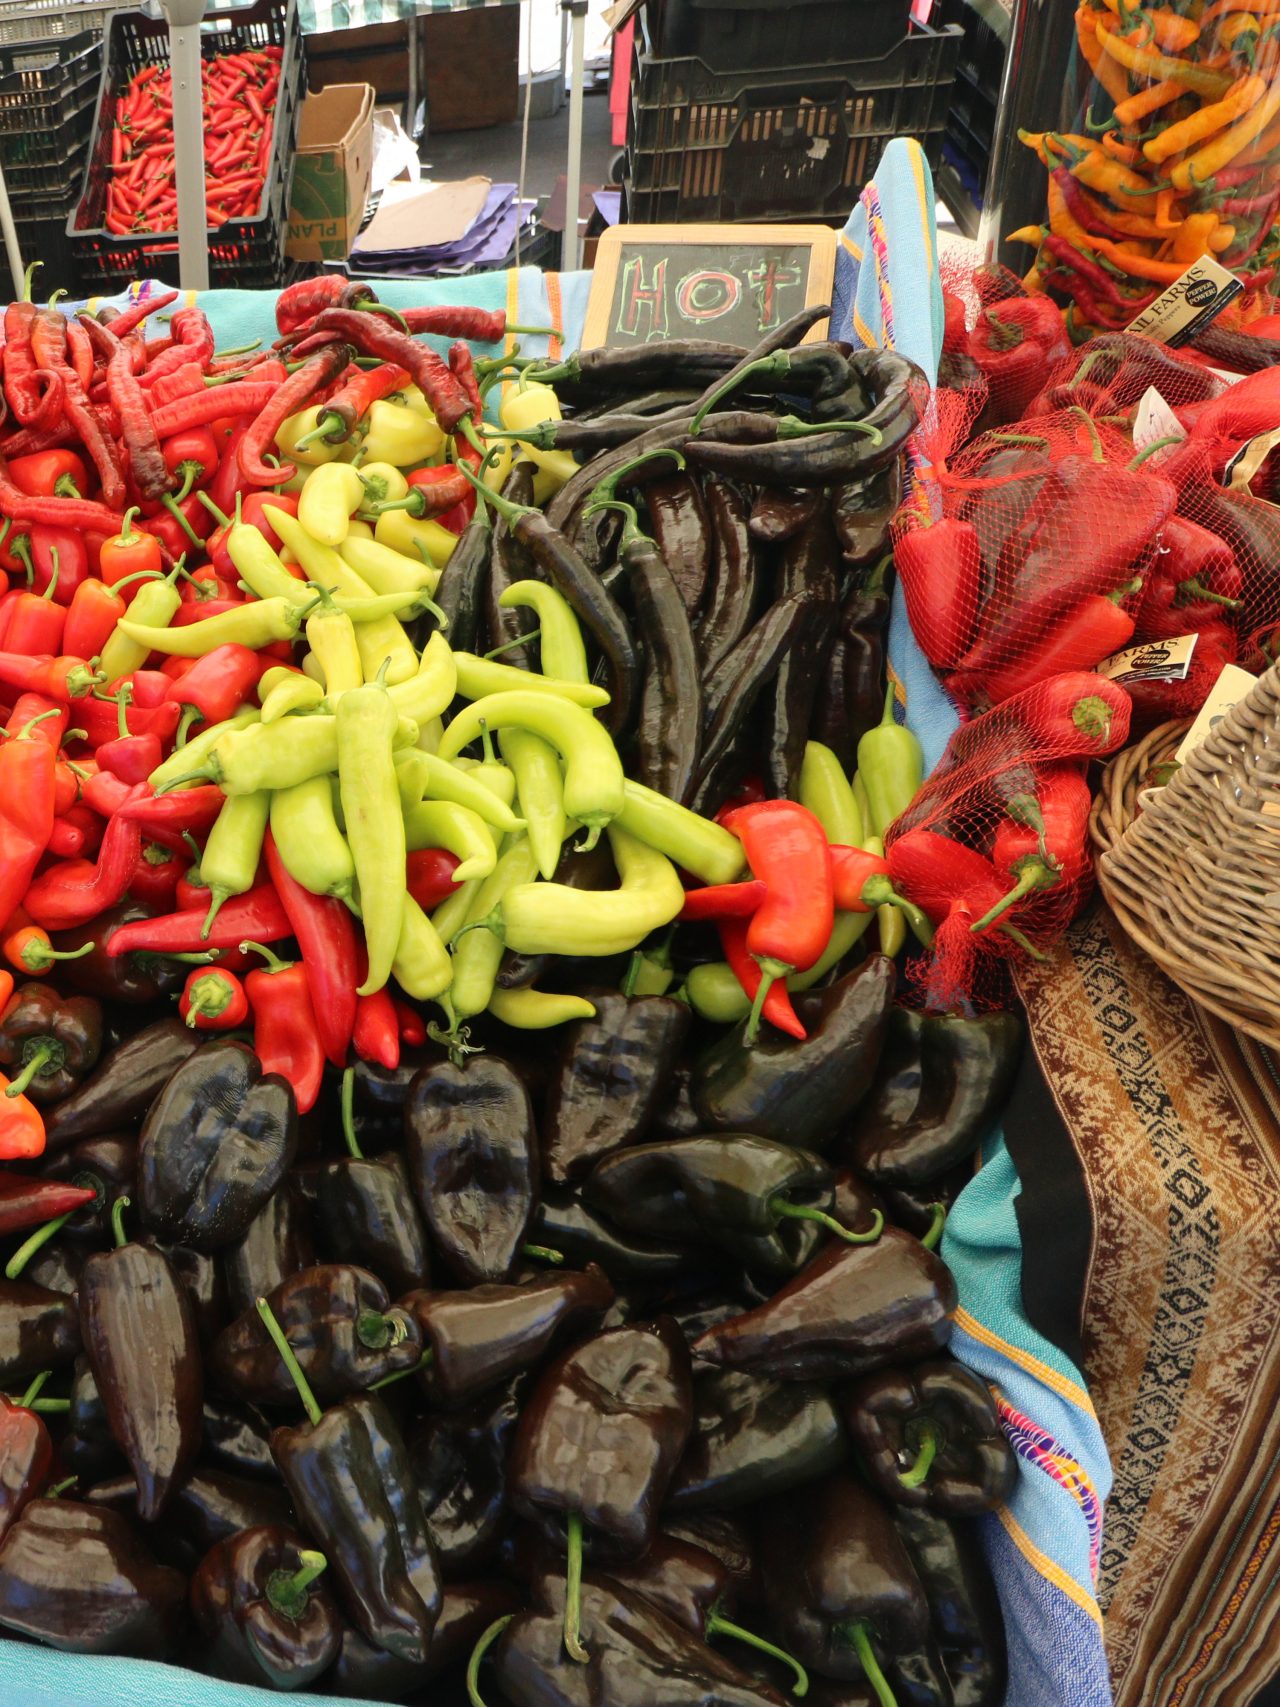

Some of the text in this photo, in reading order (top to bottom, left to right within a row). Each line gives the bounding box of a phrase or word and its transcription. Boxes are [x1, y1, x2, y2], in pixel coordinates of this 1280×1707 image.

[1186, 281, 1213, 299] PEPPER
[1188, 288, 1217, 305] POWER!
[1138, 652, 1168, 660] PEPPER
